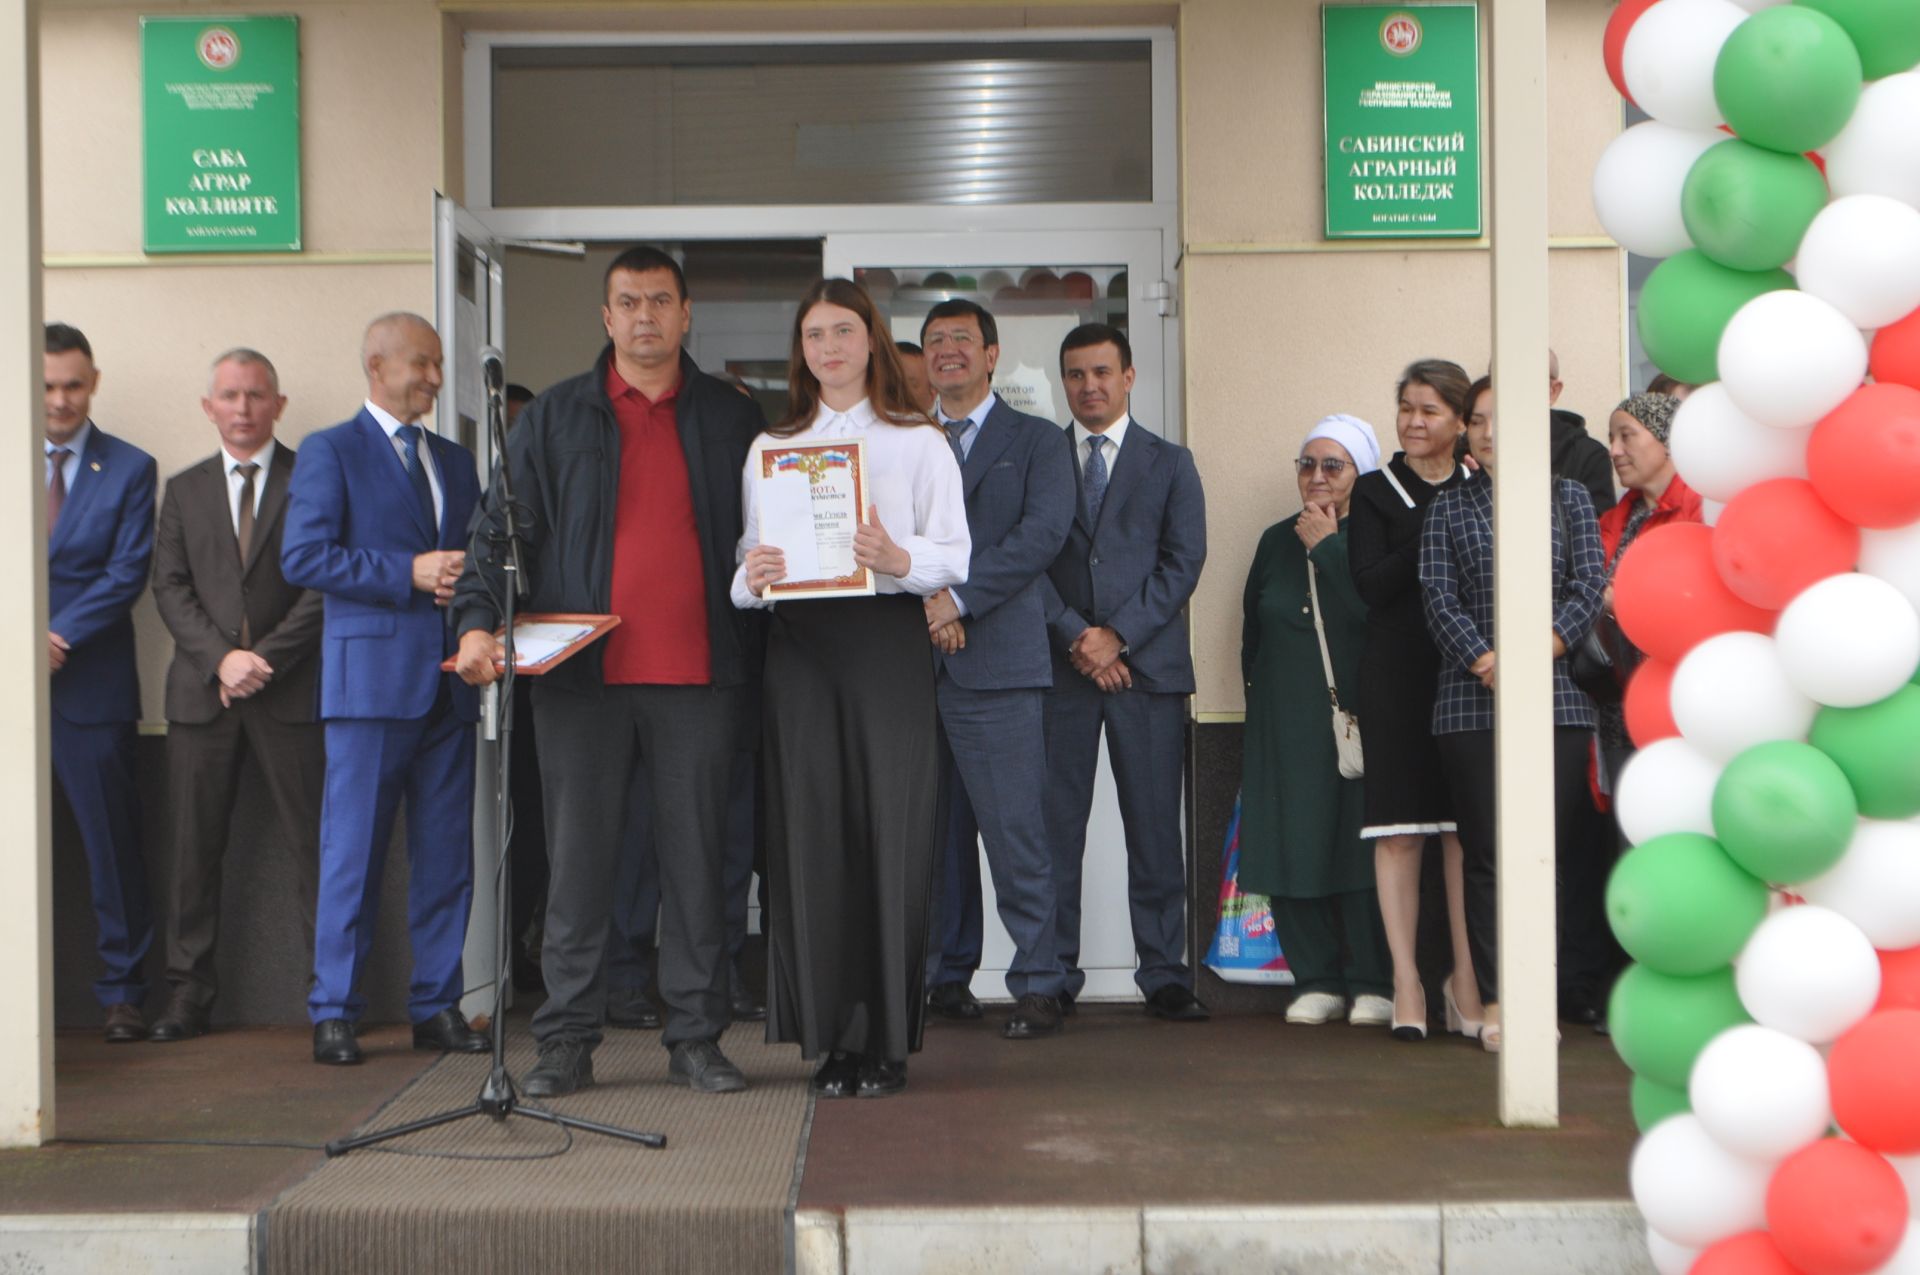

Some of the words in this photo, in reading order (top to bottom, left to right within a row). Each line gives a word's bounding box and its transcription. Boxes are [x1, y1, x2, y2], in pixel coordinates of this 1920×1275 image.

[1339, 131, 1465, 153] САБИНСКИЙ
[192, 149, 248, 168] САБА
[1349, 156, 1457, 177] АГРАРНЫЙ
[189, 173, 251, 192] АГРАР
[1354, 183, 1454, 202] КОЛЛЕДЖ
